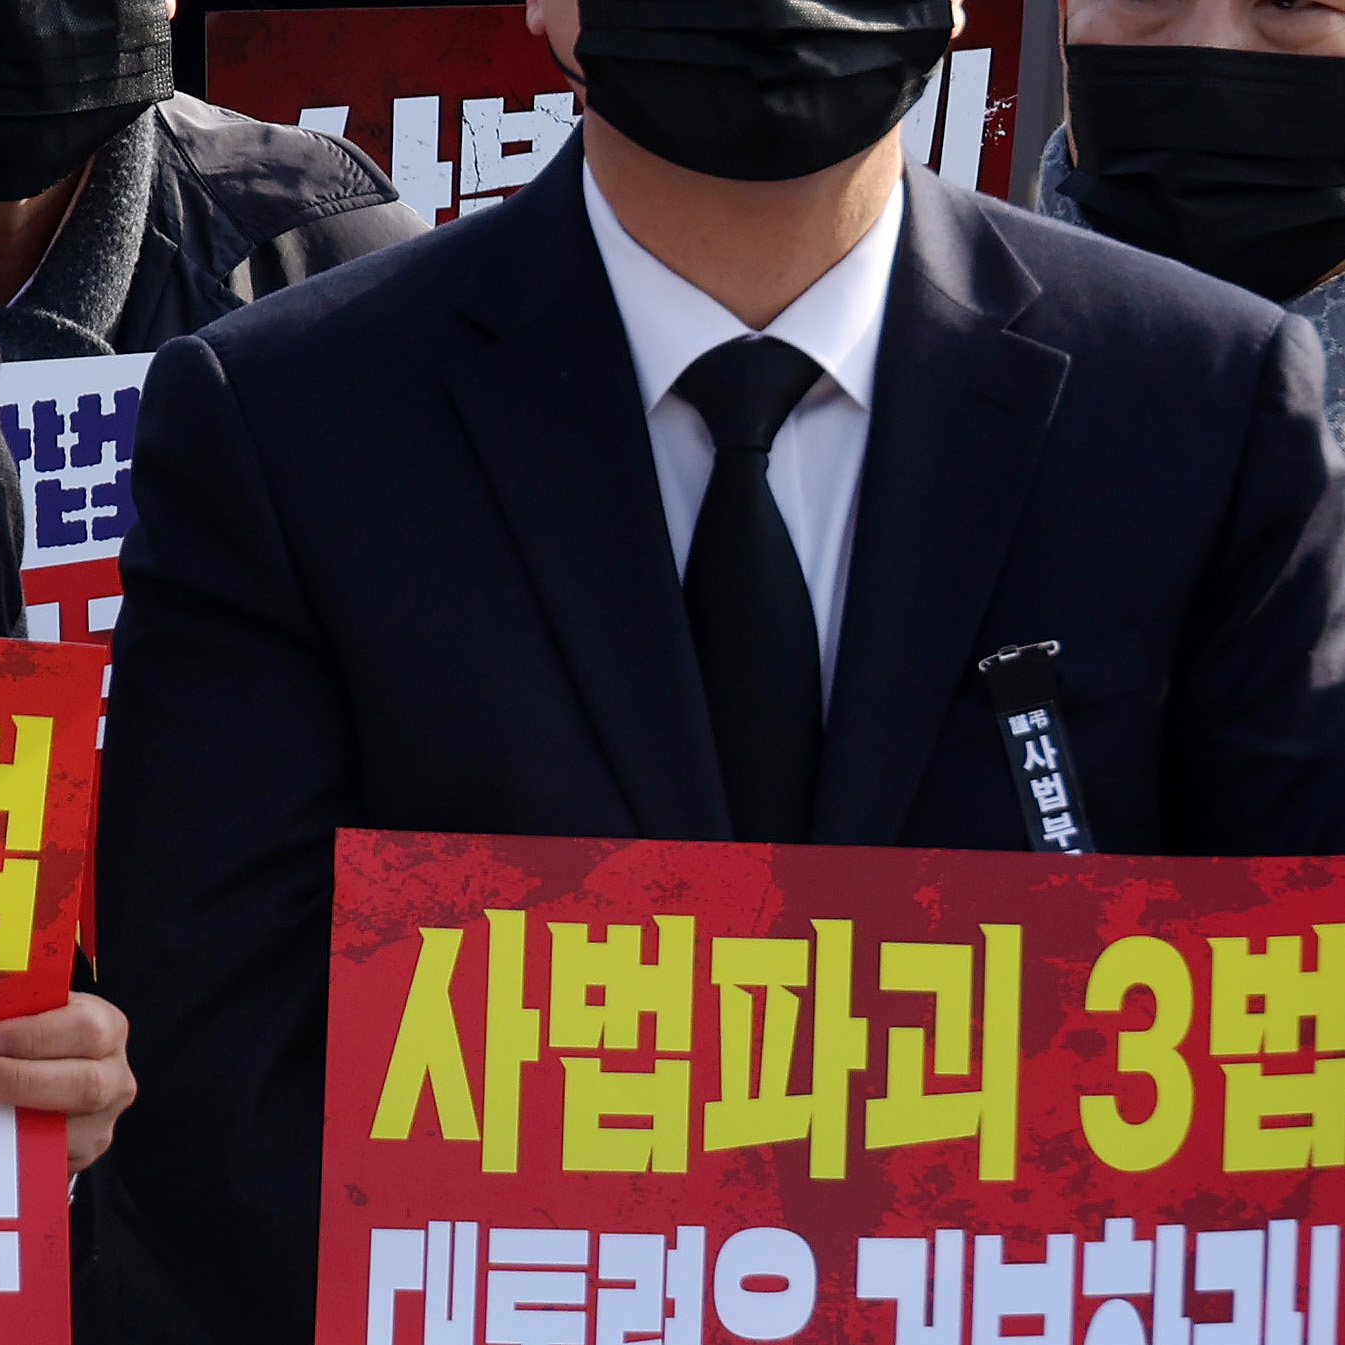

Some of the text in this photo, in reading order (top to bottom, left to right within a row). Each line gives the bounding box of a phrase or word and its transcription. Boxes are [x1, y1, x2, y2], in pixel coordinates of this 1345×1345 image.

[1023, 733, 1083, 855] 사법부
[370, 908, 1345, 1181] 사법파괴 3법
